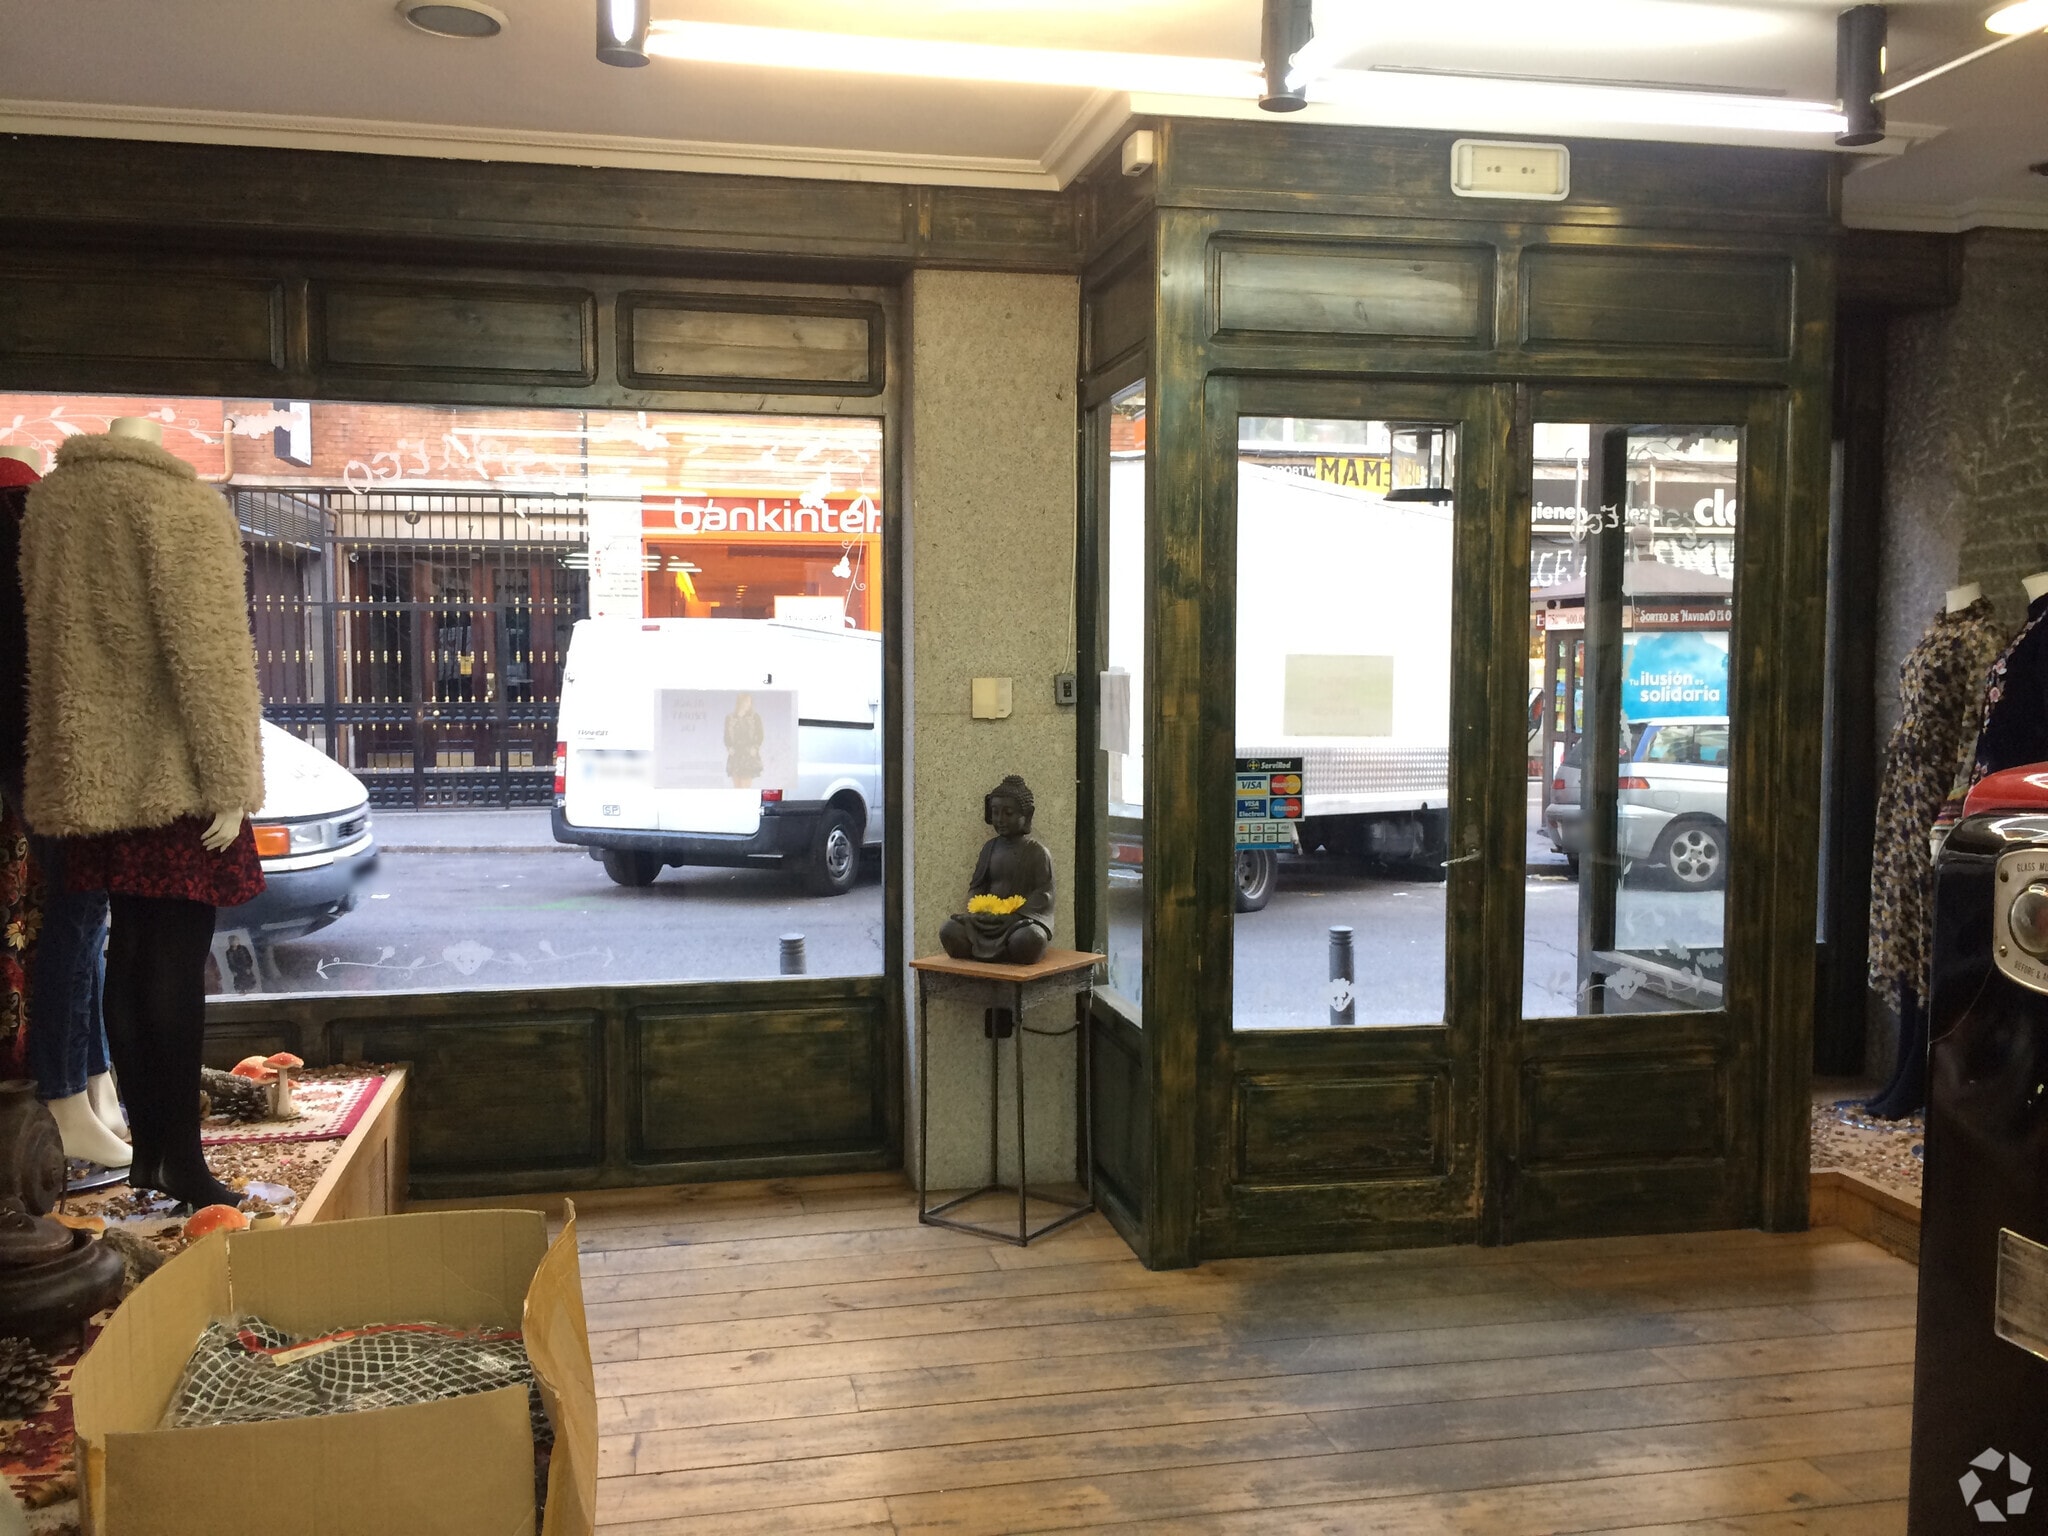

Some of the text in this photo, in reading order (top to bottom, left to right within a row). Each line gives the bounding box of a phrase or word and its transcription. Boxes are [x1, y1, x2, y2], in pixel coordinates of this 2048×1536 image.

[407, 511, 418, 523] 7
[1640, 671, 1693, 686] ilusión
[1640, 686, 1720, 702] solidaria
[1241, 781, 1262, 789] VISA
